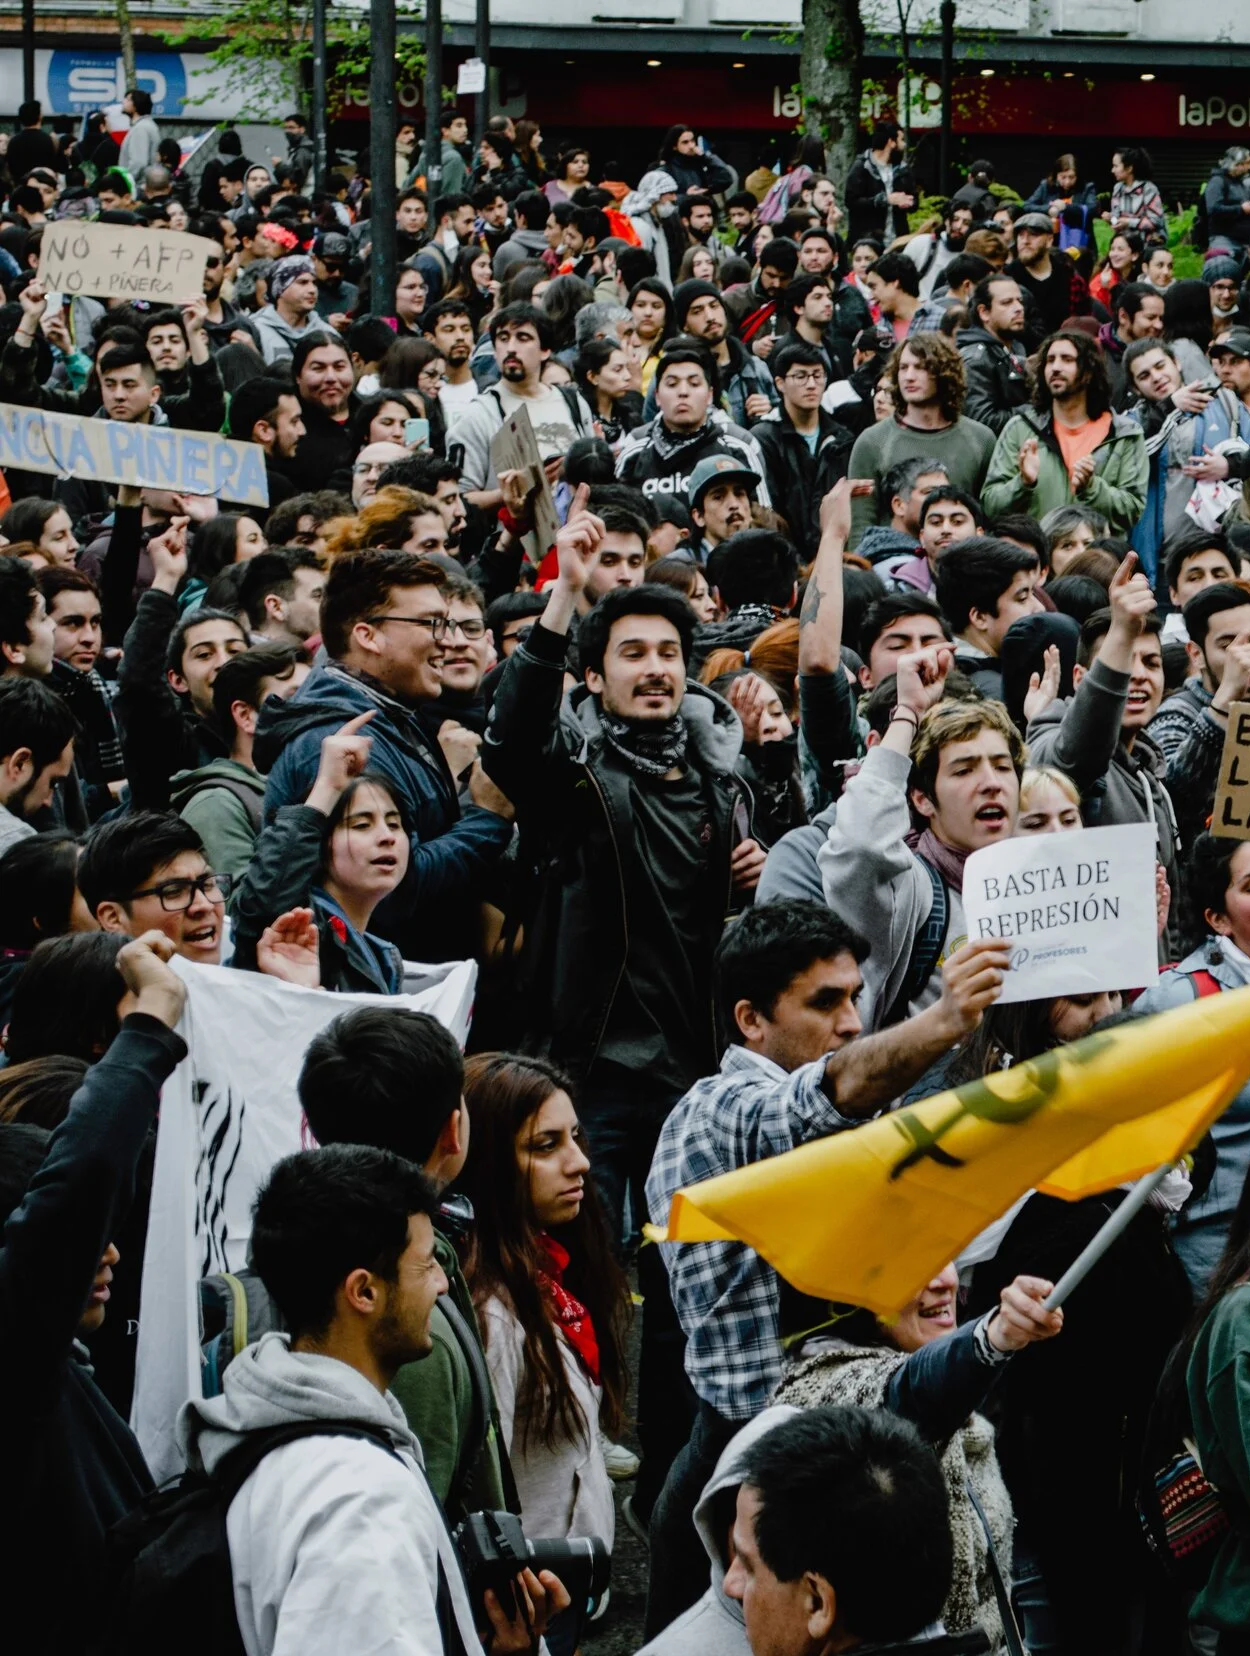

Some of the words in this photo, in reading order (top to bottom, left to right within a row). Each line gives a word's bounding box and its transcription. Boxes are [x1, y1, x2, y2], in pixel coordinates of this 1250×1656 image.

[133, 240, 195, 273] AFP
[105, 422, 269, 507] PIÑERA
[984, 865, 1067, 901] BASTA
[1077, 860, 1110, 886] DE
[978, 893, 1120, 939] REPRESIÓN
